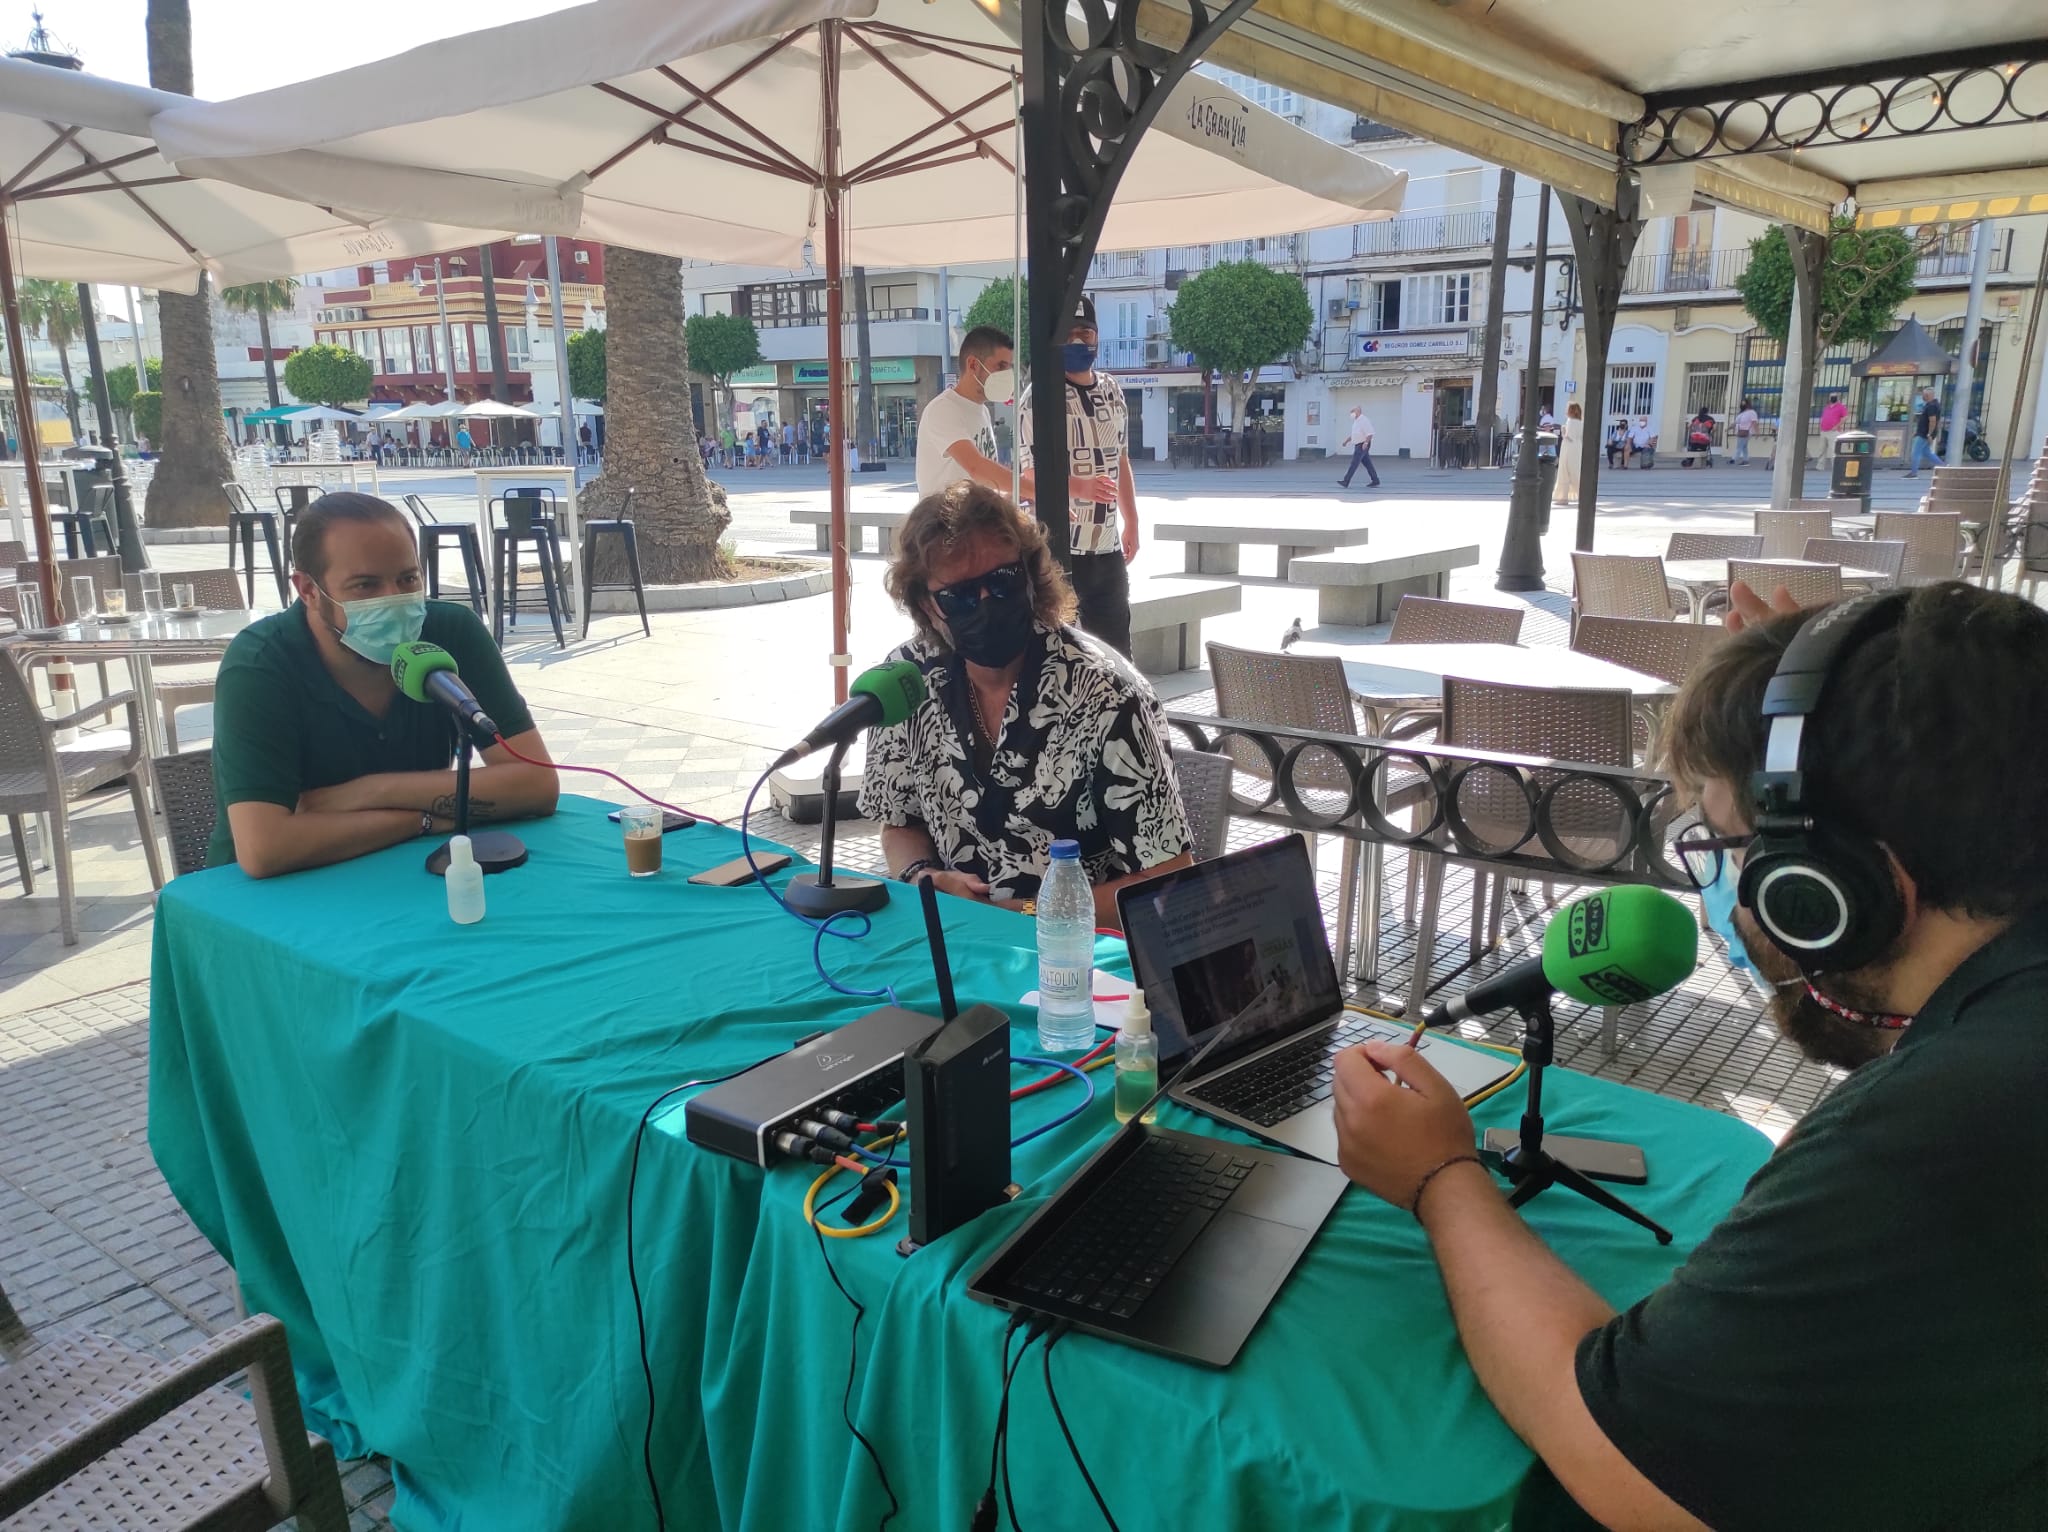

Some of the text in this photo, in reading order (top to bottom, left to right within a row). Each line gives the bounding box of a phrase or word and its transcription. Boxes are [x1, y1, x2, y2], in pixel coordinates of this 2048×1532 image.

[1191, 96, 1203, 129] LA
[1205, 104, 1231, 140] GRAN
[1574, 907, 1584, 946] CERO
